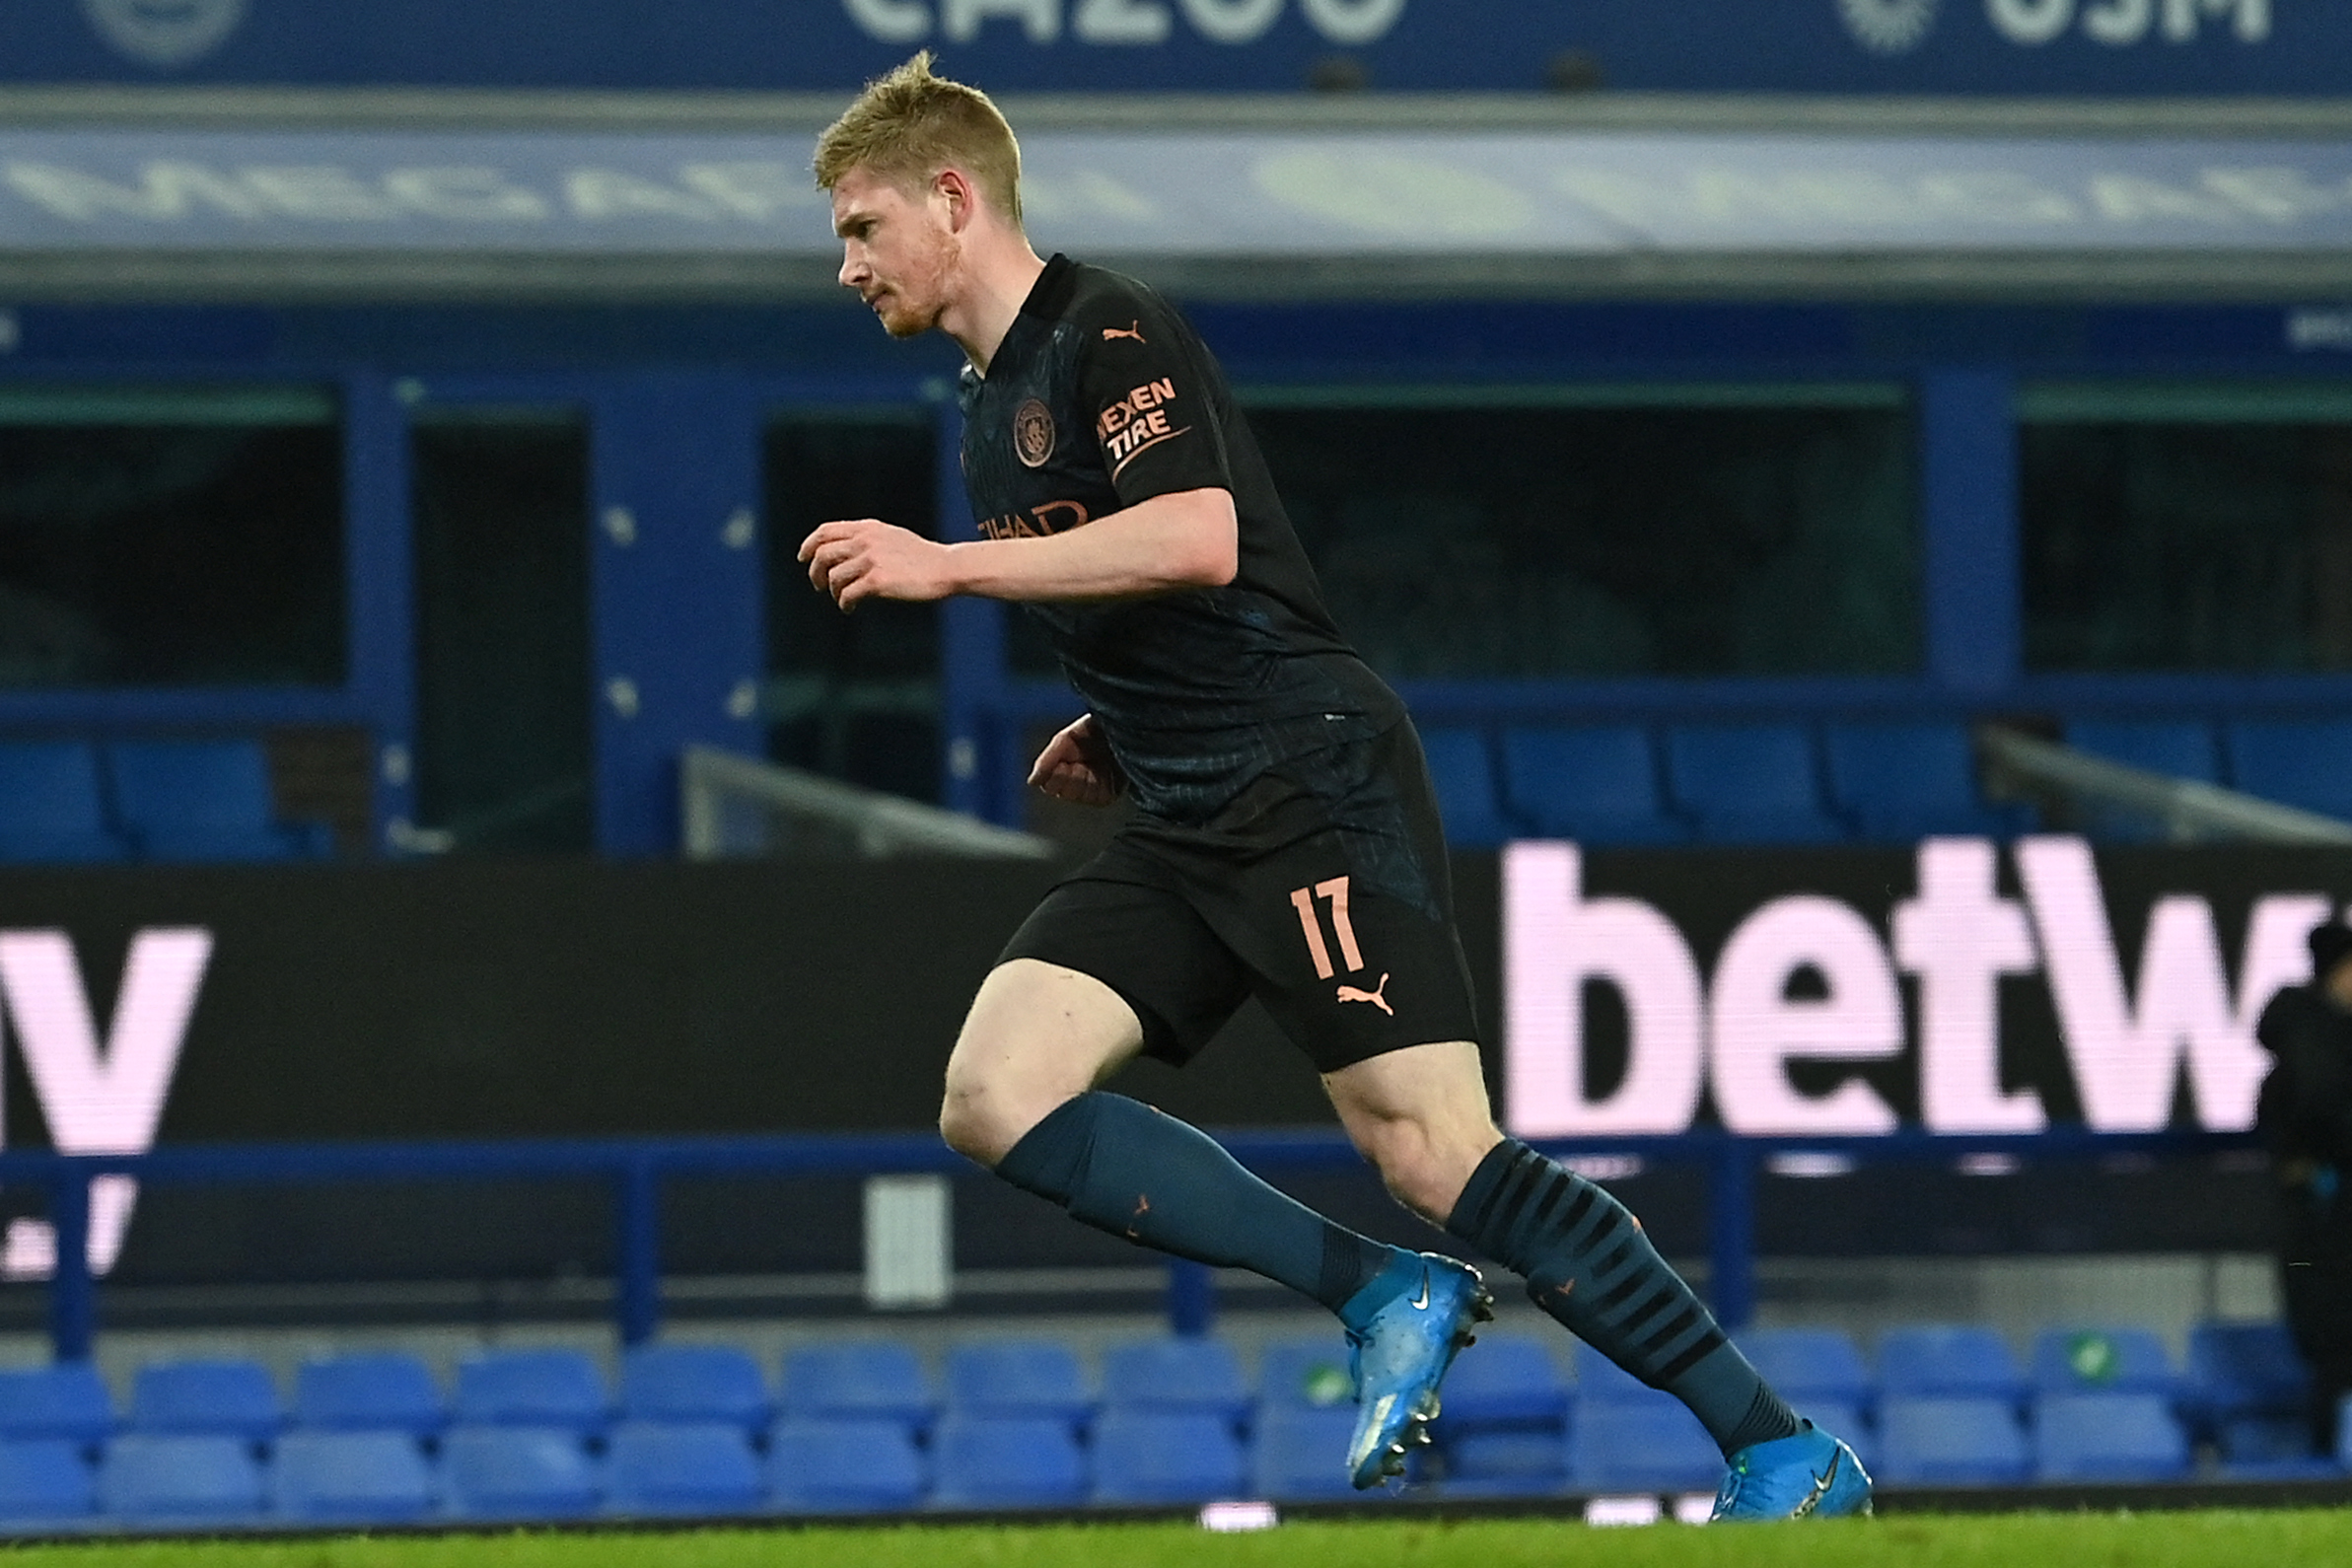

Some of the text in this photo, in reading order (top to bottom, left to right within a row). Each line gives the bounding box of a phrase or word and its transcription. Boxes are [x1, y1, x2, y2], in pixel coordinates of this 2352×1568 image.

[1105, 408, 1173, 461] TIRE
[1290, 875, 1365, 980] 17
[1500, 834, 2352, 1176] betw
